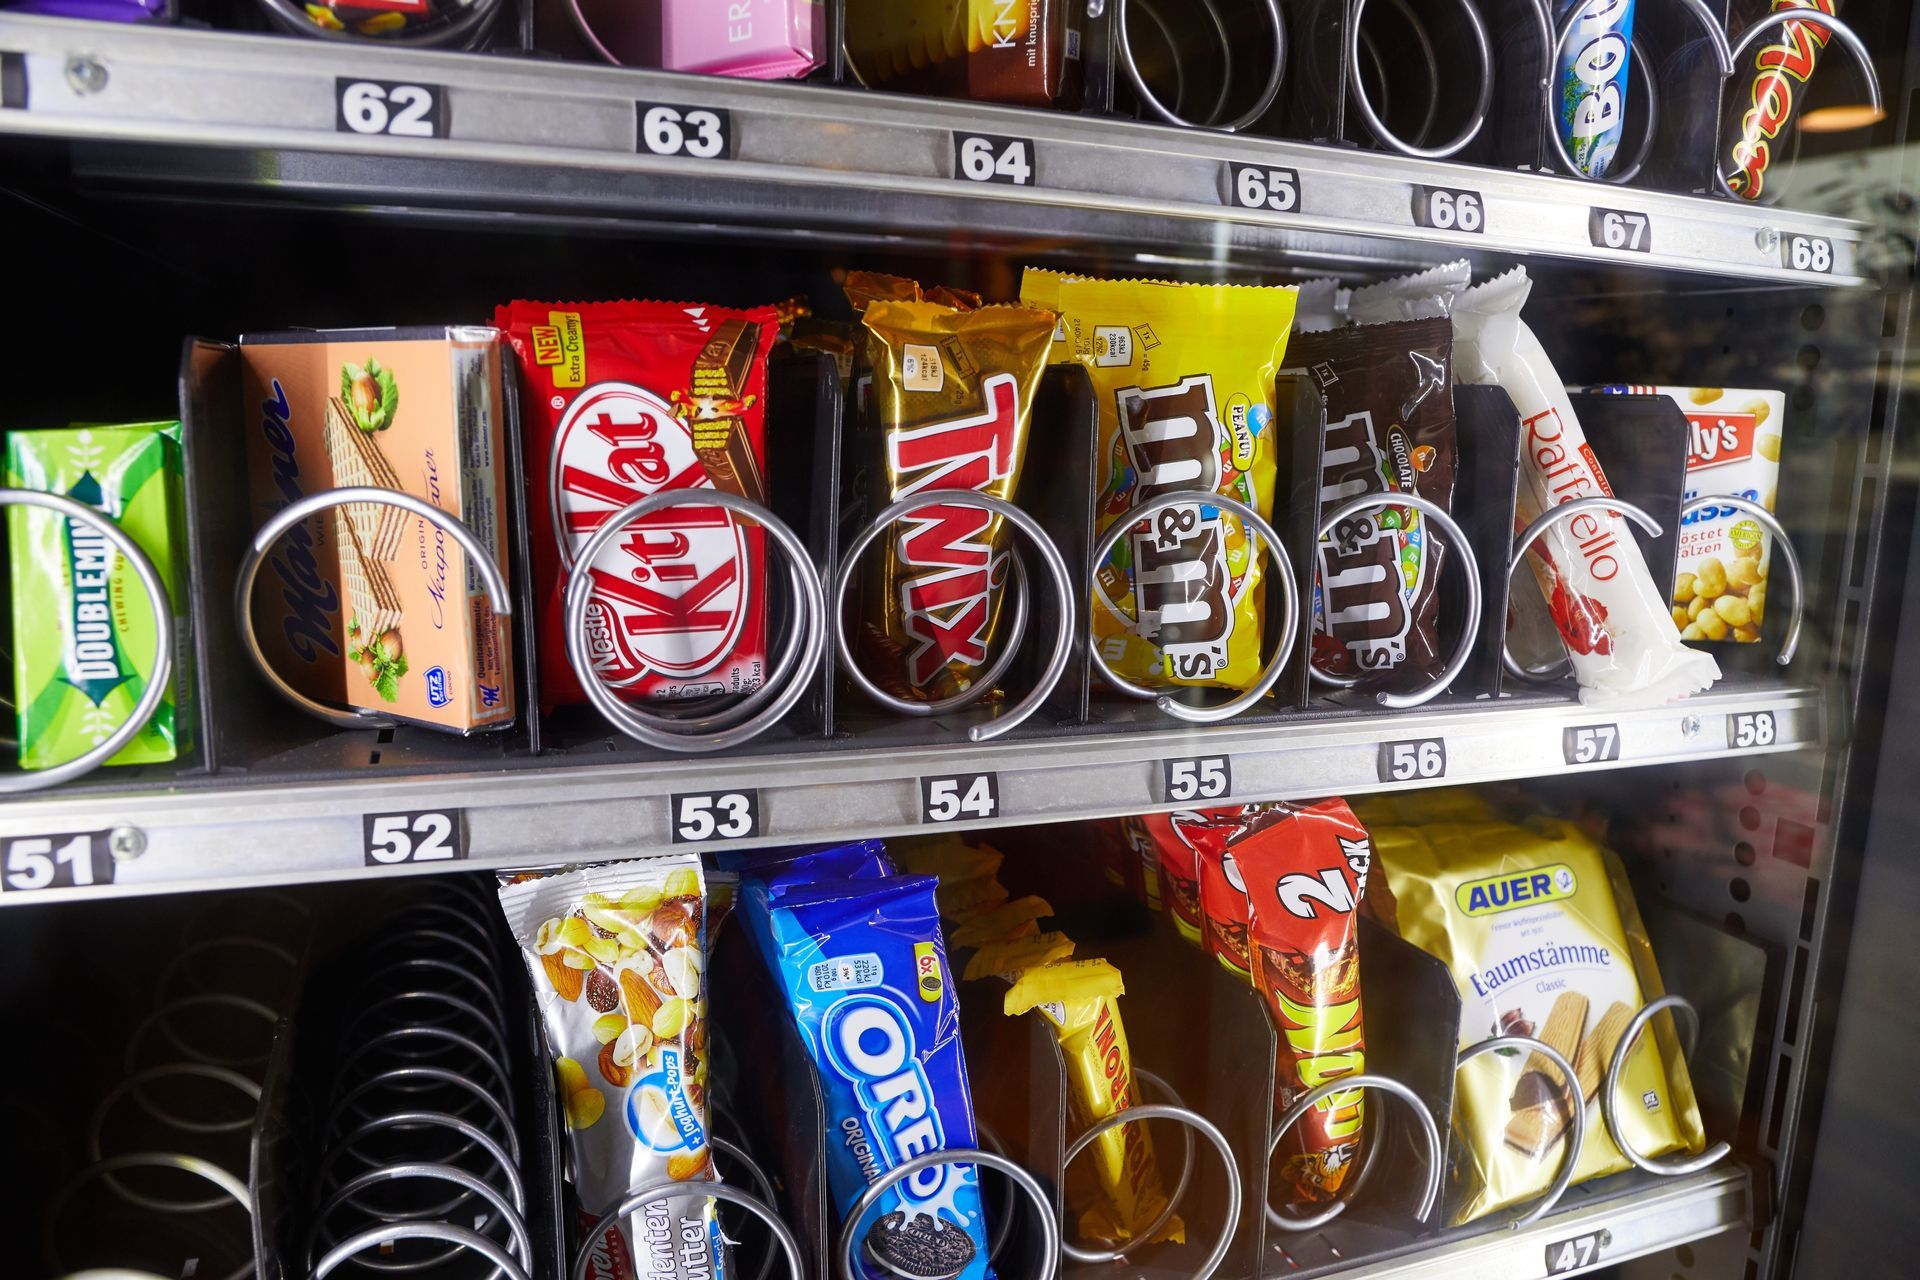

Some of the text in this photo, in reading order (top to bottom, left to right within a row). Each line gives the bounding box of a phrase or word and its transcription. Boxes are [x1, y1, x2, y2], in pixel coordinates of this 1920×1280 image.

[1027, 48, 1036, 67] mit
[342, 82, 433, 136] 62
[643, 107, 724, 158] 63
[961, 137, 1030, 184] 64
[1238, 168, 1296, 211] 65
[1430, 190, 1481, 231] 66
[1602, 213, 1648, 251] 67
[1792, 236, 1831, 272] 68
[536, 328, 560, 361] NEW
[566, 315, 580, 382] Extra Creamy!
[1109, 333, 1117, 358] 230kcal
[1232, 404, 1250, 459] PEANUT
[1390, 432, 1412, 488] CHOCOLATE
[315, 514, 324, 547] WIE
[418, 519, 427, 570] ORIGIN
[113, 549, 125, 572] GU
[428, 674, 439, 701] UTZ
[1575, 728, 1617, 763] 57
[1735, 712, 1775, 746] 58
[1169, 758, 1227, 799] 55
[1392, 741, 1442, 780] 56
[678, 794, 753, 838] 53
[928, 775, 994, 817] 54
[370, 813, 454, 863] 52
[6, 835, 94, 888] 51
[1277, 867, 1357, 919] 2
[1469, 873, 1552, 912] AUER
[920, 955, 934, 975] 6x
[1536, 978, 1567, 994] Classic
[841, 1006, 946, 1198] OREO
[1556, 1236, 1598, 1271] 47
